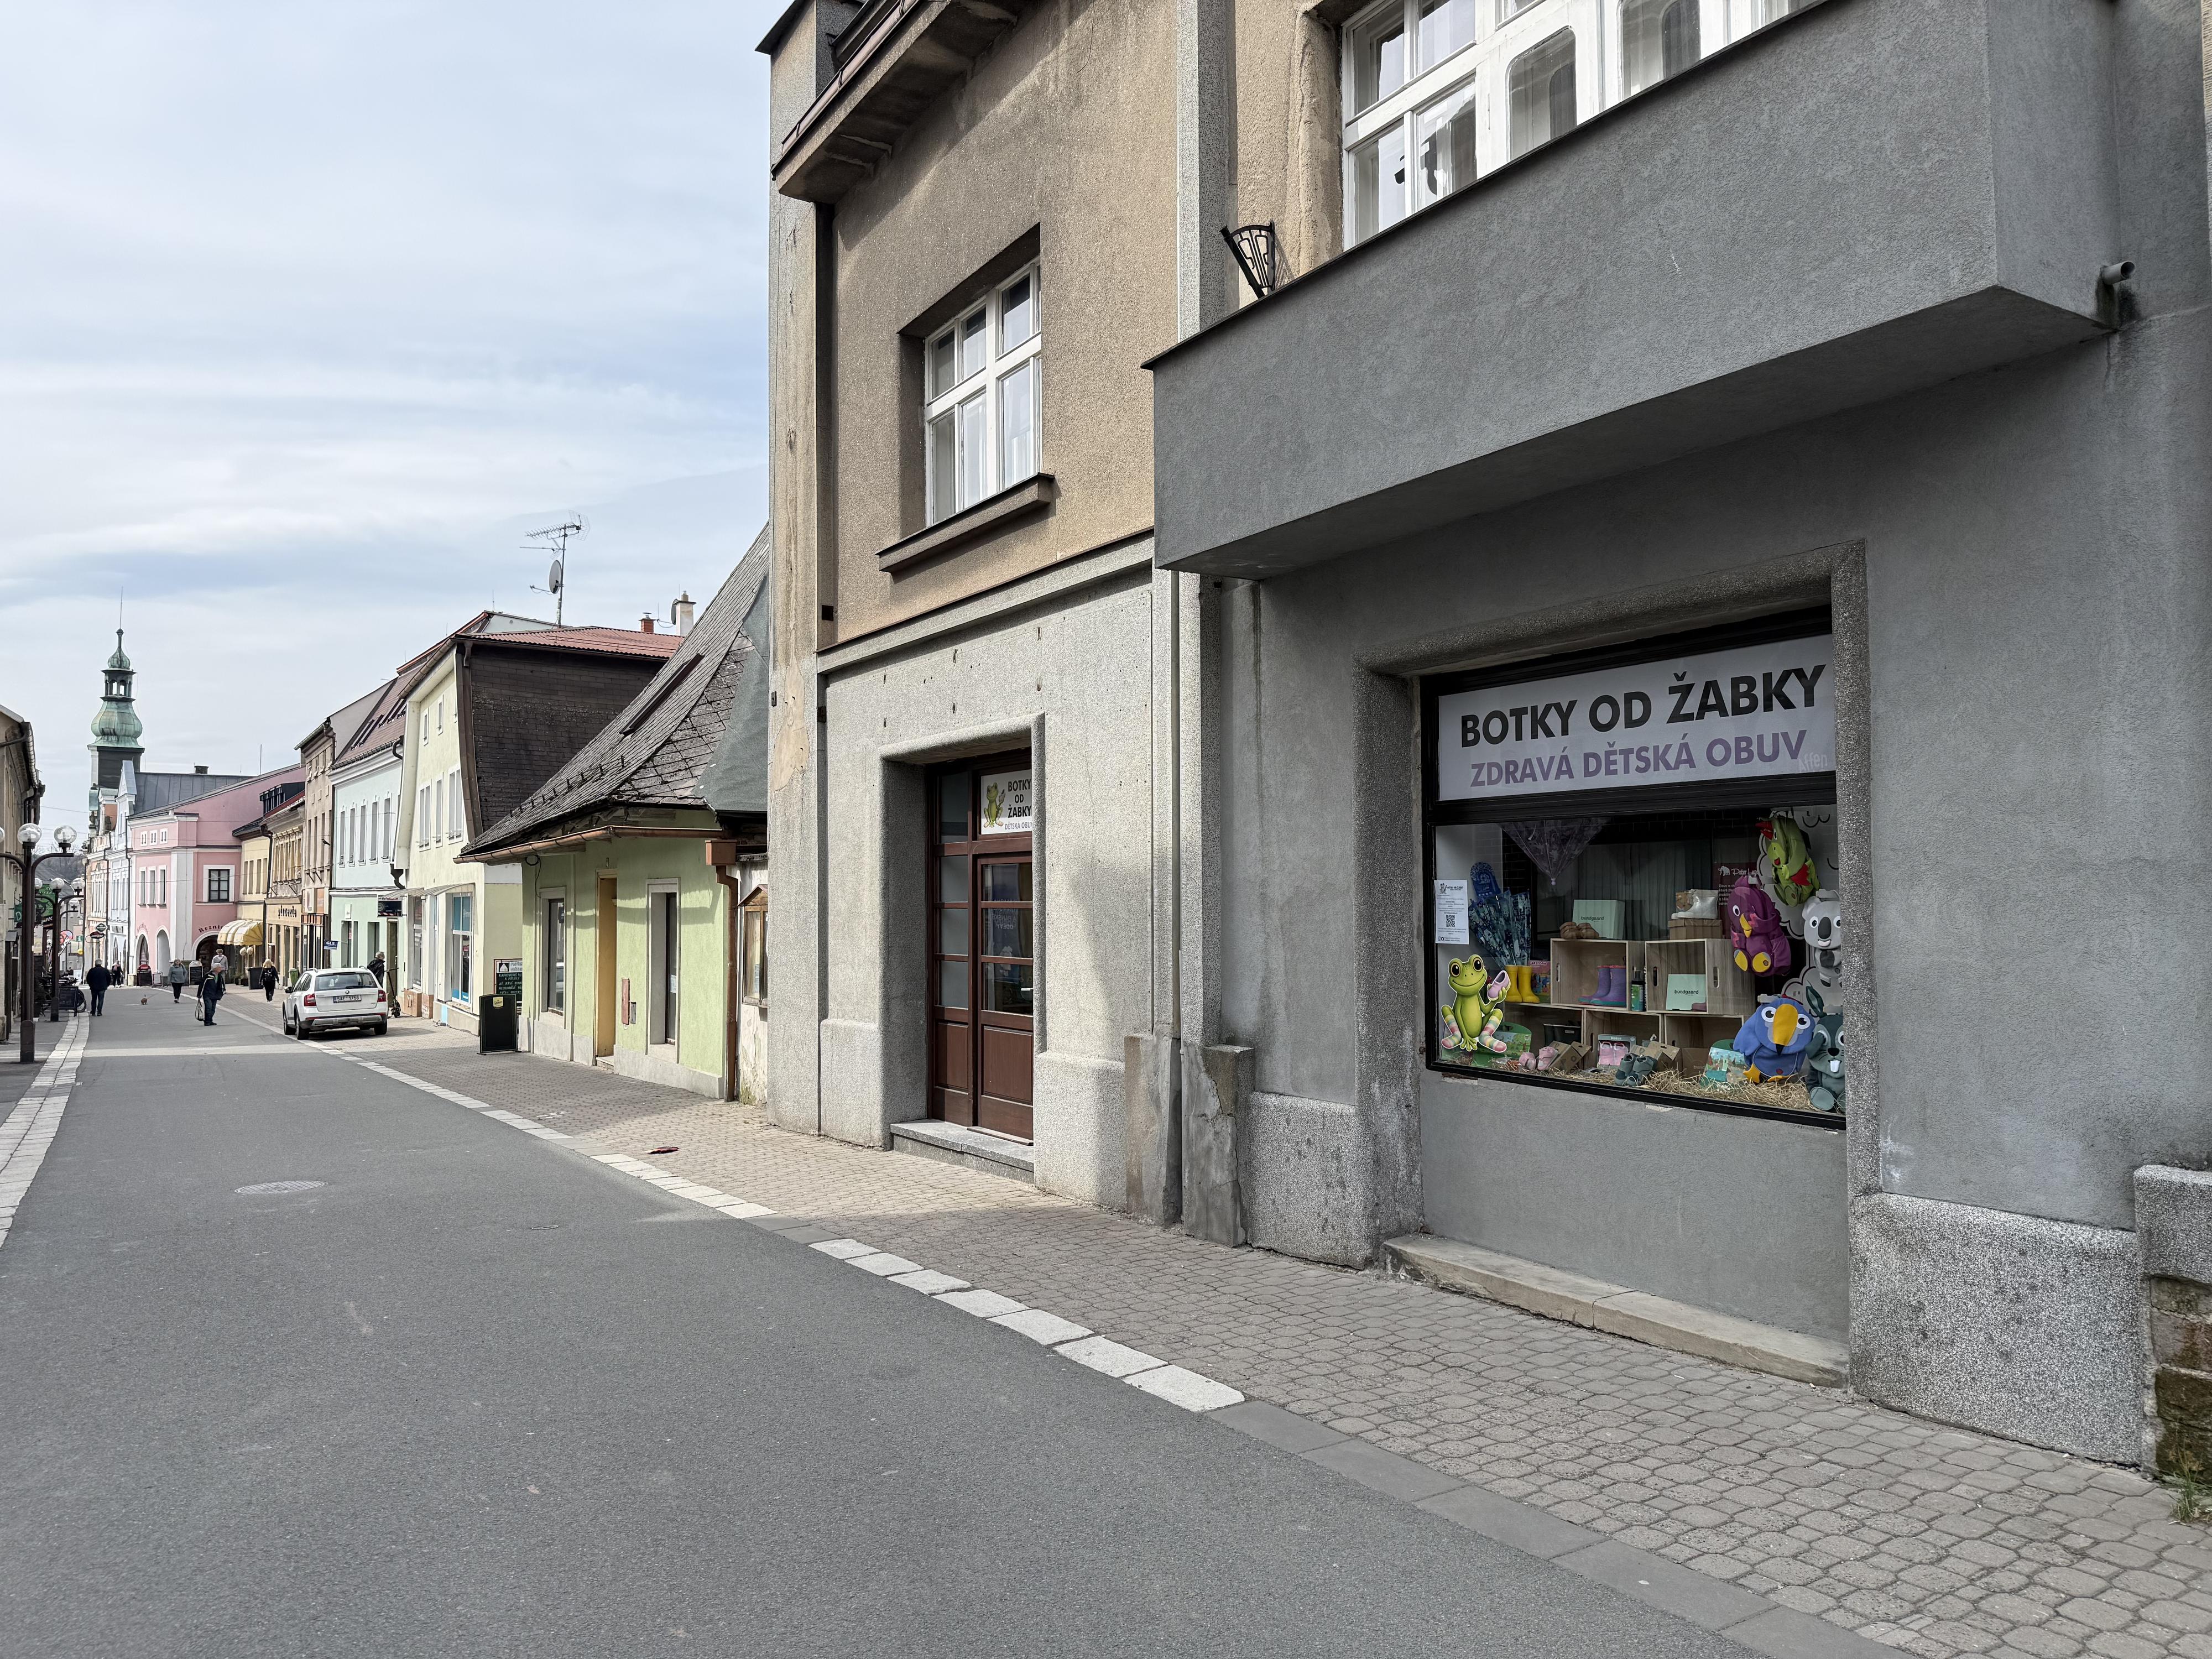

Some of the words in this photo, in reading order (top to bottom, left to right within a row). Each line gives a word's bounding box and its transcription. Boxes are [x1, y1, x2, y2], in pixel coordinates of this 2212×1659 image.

[1460, 699, 1578, 748] BOTKY
[1588, 690, 1652, 733] OD
[1666, 664, 1827, 724] ŽABKY
[1469, 745, 1574, 788] ZDRAVÁ
[1583, 733, 1697, 779] DĚTSKÁ
[1705, 729, 1807, 768] OBUV
[1008, 779, 1032, 792] BOTKY
[1014, 794, 1024, 804] OD
[1008, 804, 1032, 818] ŽABKY
